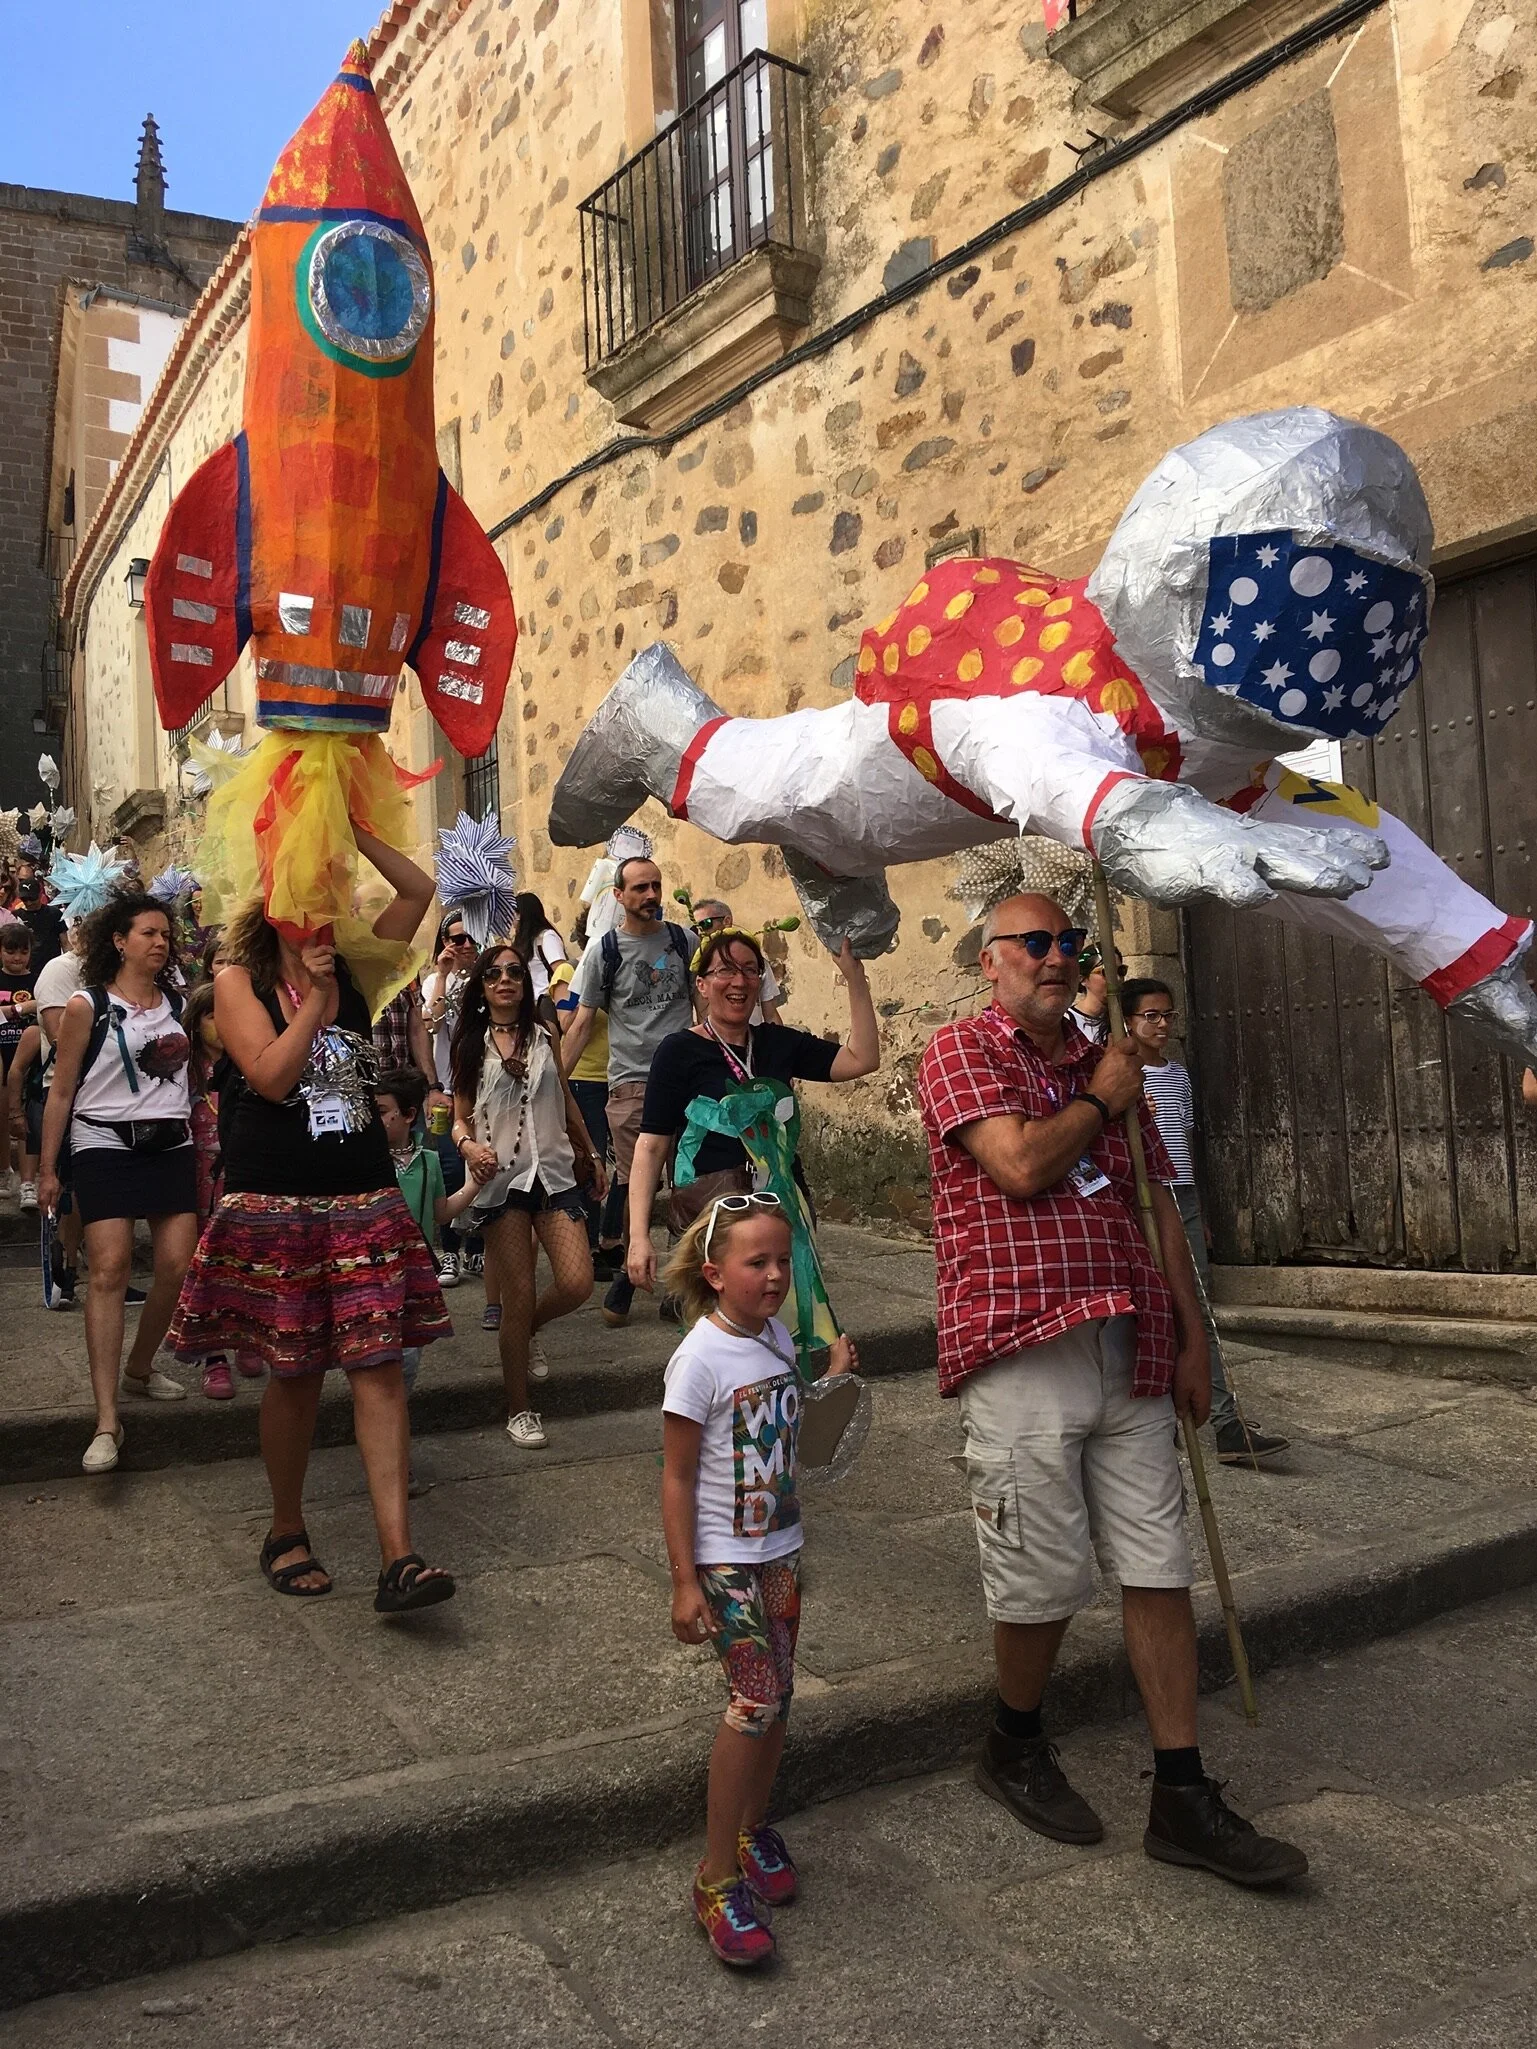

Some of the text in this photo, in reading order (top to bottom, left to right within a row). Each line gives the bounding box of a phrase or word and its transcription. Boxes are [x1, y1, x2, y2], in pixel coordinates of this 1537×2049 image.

[739, 1390, 748, 1399] EL
[748, 1381, 772, 1395] FESTIVAL
[772, 1378, 784, 1387] DEL
[740, 1385, 798, 1440] WO
[742, 1491, 777, 1532] D
